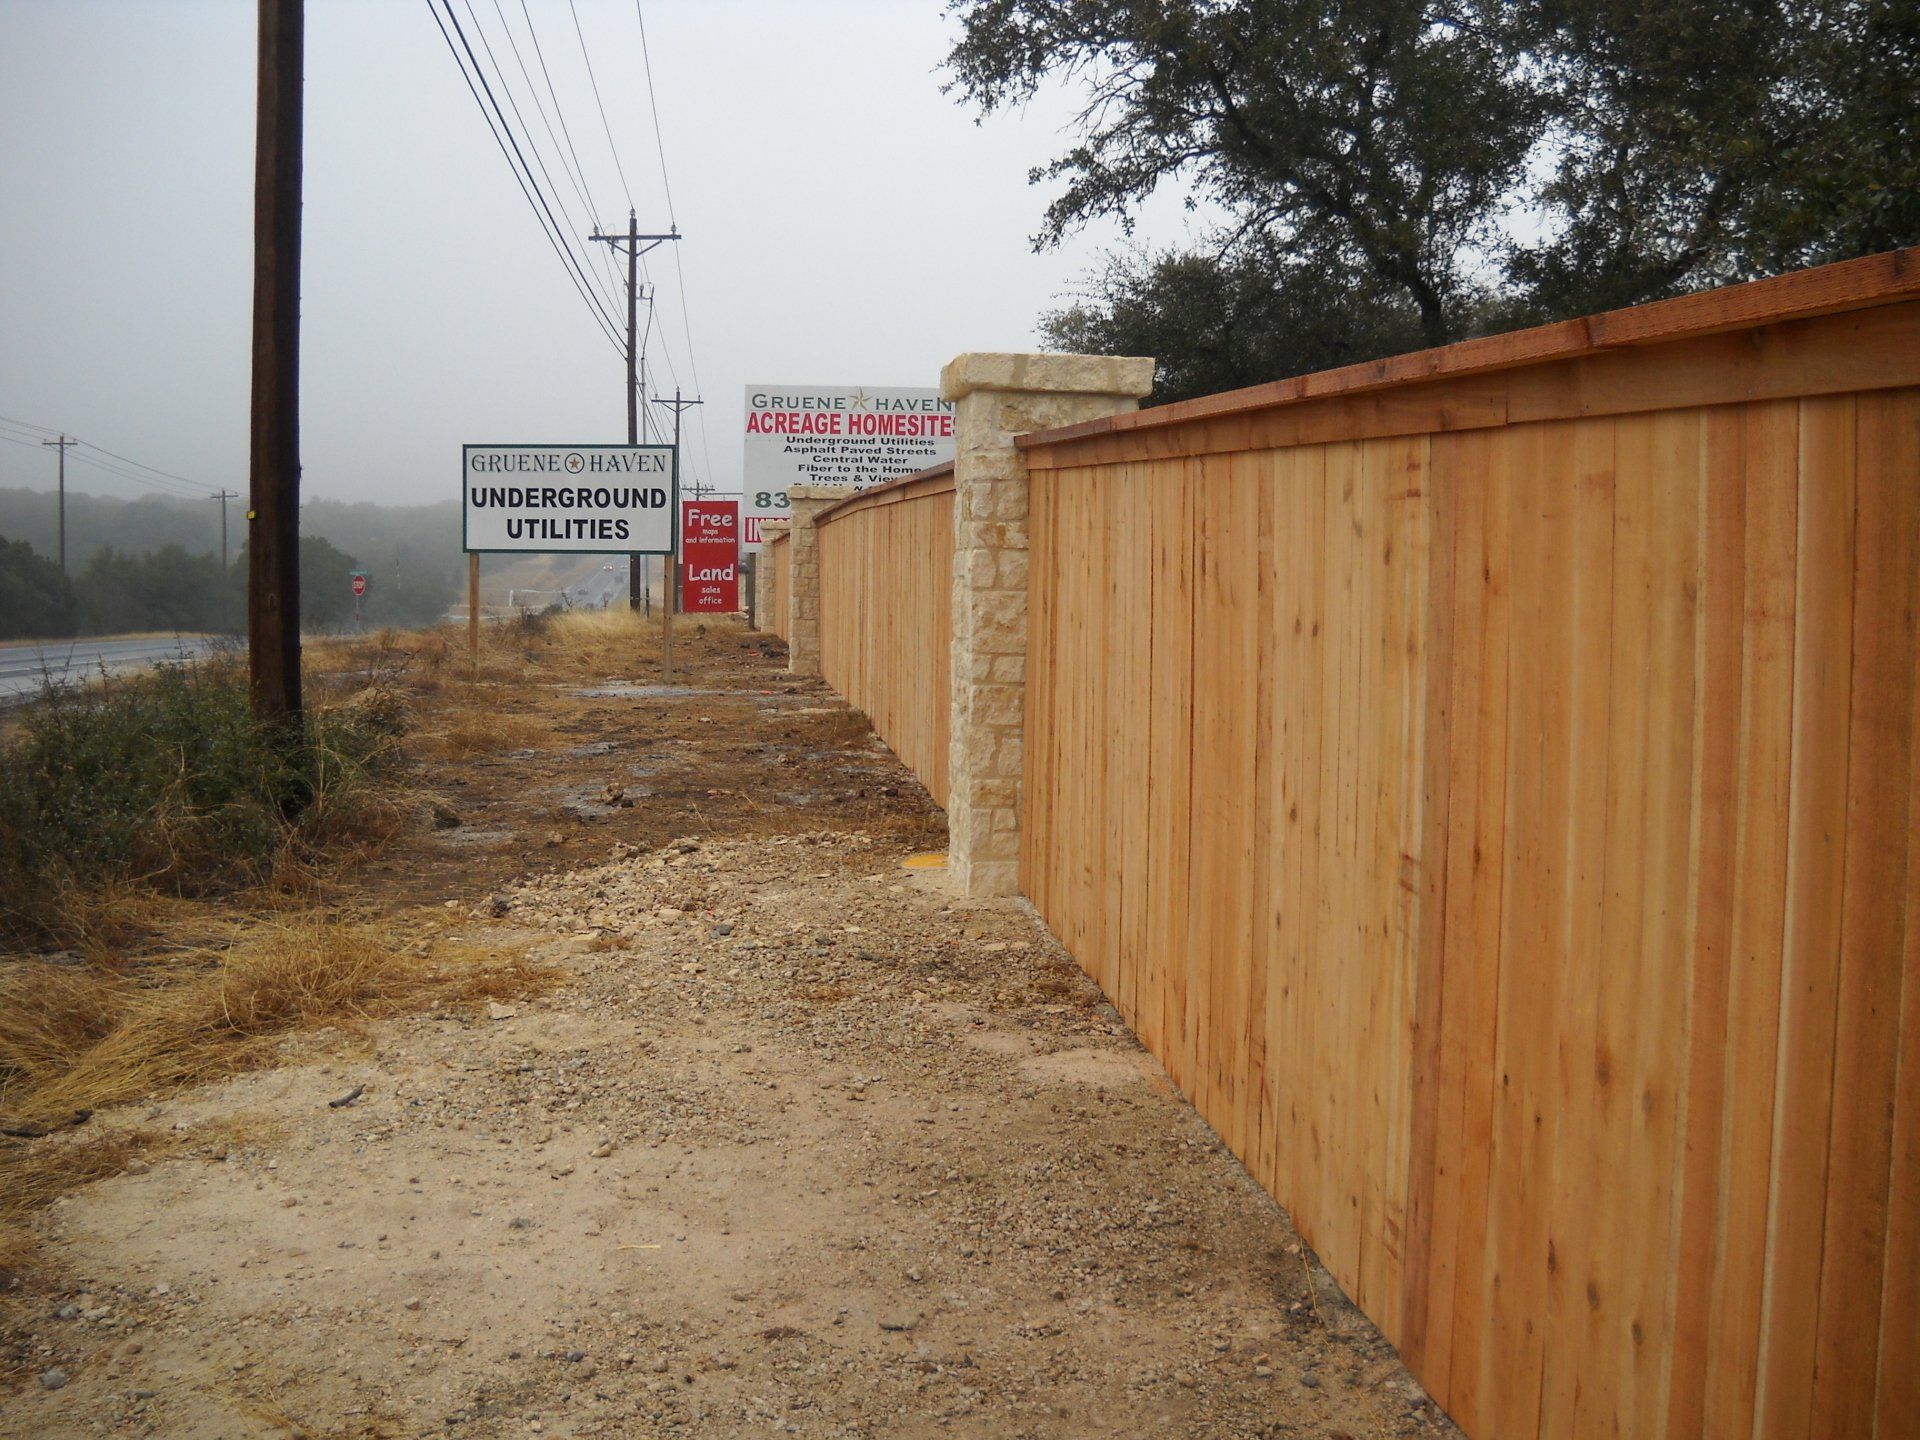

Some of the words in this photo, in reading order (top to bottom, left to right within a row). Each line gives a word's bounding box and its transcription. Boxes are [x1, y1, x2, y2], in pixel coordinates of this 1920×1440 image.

[752, 394, 846, 410] GRUENE
[876, 397, 953, 411] HAVEN
[747, 412, 841, 435] ACREAGE
[786, 436, 876, 446] Underground
[881, 437, 935, 446] Utilities
[784, 445, 836, 455] Asphalt
[841, 446, 882, 455] Paved
[887, 446, 937, 456] Streets
[472, 454, 560, 473] GRUENE
[590, 452, 666, 472] HAVEN
[812, 455, 863, 463] Central
[868, 456, 908, 464] Water
[798, 464, 833, 473] Fiber
[837, 465, 851, 473] to
[855, 465, 878, 473] the
[882, 465, 922, 474] Home
[809, 474, 848, 482] Trees
[853, 474, 866, 482] &
[471, 488, 667, 508] UNDERGROUND
[688, 508, 733, 527] Free
[507, 519, 630, 540] UTILITIES
[688, 564, 734, 581] Land
[701, 586, 721, 594] sales
[699, 596, 722, 605] office
